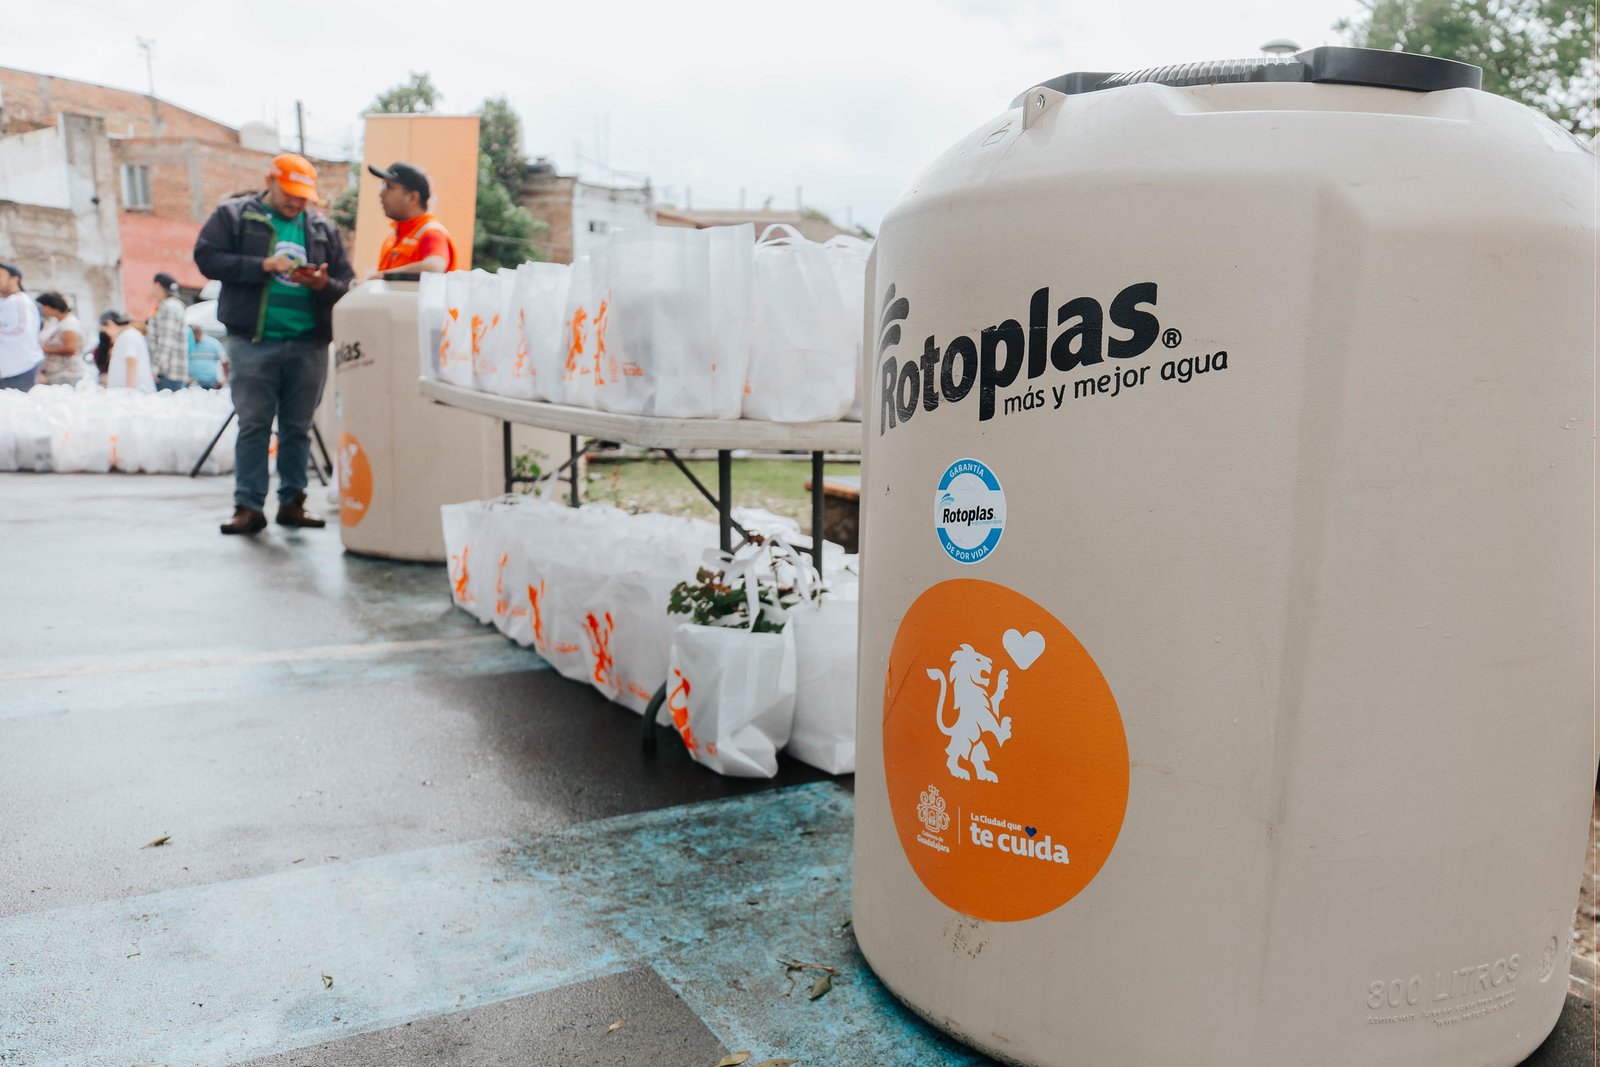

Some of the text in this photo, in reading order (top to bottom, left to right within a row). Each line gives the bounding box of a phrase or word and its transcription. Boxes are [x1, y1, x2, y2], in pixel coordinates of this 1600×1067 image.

[1004, 350, 1228, 415] más y mejor agua
[945, 542, 989, 560] DE POR VIDA
[969, 822, 1070, 864] te cuida
[970, 813, 1022, 831] La Ciudad que
[1366, 975, 1423, 1010] 800
[1432, 953, 1520, 1003] LITROS
